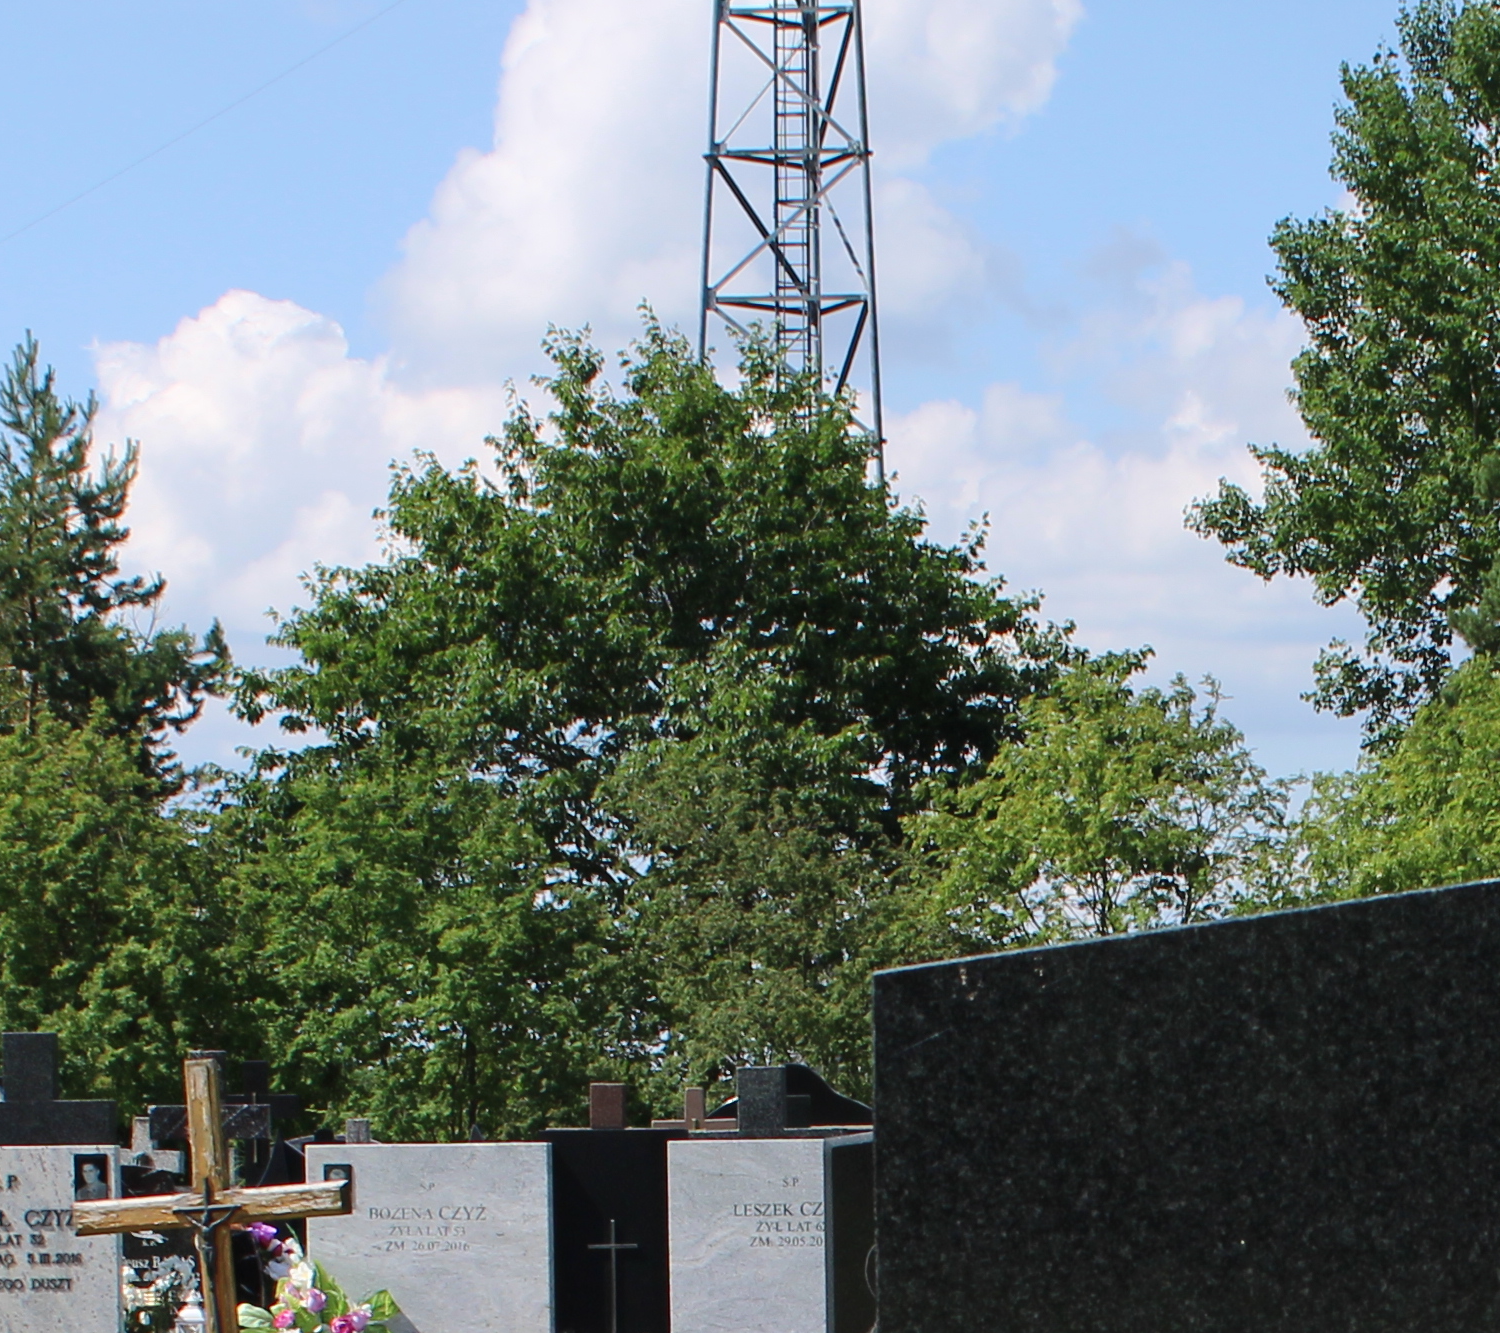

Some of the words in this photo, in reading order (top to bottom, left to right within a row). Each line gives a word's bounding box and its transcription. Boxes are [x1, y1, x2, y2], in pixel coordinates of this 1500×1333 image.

[438, 1204, 487, 1220] CZYŻ
[733, 1203, 794, 1216] LESZEK
[787, 1222, 812, 1232] LAT
